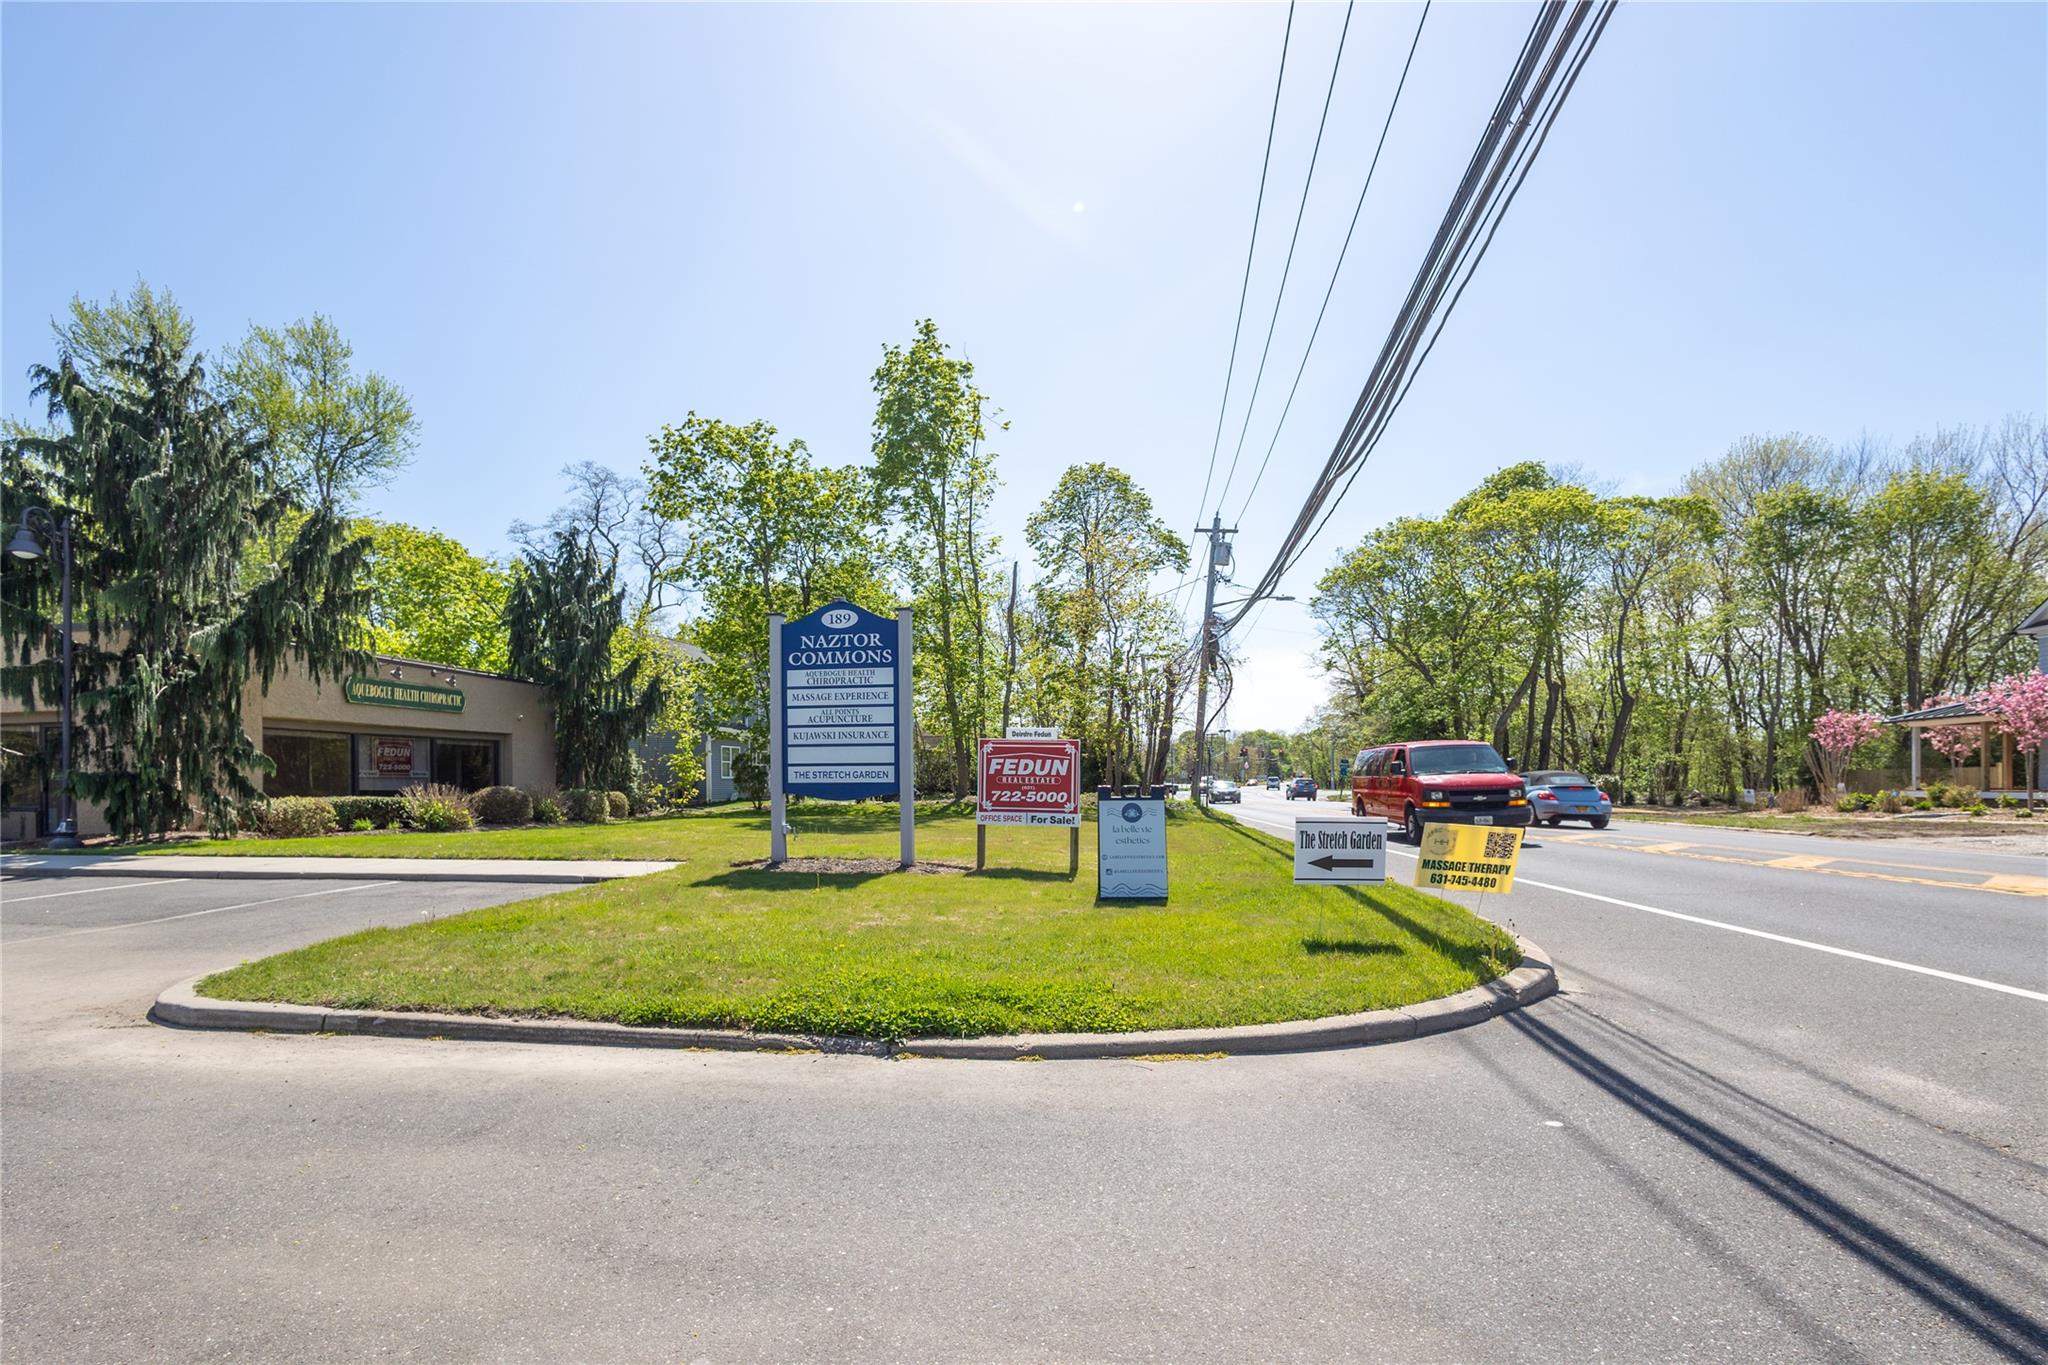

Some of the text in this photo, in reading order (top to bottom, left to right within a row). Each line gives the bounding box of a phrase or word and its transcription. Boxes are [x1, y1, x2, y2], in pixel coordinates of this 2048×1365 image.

[828, 613, 851, 625] 189
[801, 633, 883, 649] NAZTOR
[788, 649, 892, 666] COMMONS
[805, 669, 876, 678] AQUEBOGUE HEALTH
[806, 676, 874, 686] CHIROPRACTIC
[352, 683, 462, 707] AQUEBOGUE HEALTH CHIROPRACTIC
[792, 691, 889, 701] MASSAGE EXPERIENCE
[807, 714, 874, 724] ACUPUNCTURE
[793, 730, 890, 741] KUJAWSKI INSURANCE
[1011, 730, 1052, 738] Deirdre Fedun
[377, 747, 411, 757] FEDUN
[988, 758, 1070, 776] FEDUN
[794, 770, 889, 779] THE STRETCH GARDEN
[1002, 776, 1056, 785] REAL ESTATE
[991, 790, 1068, 803] 722-5000
[980, 815, 1023, 823] OFFICE SPACE
[1030, 815, 1076, 825] For Sale!
[1120, 825, 1140, 834] belle
[1115, 836, 1151, 845] esthetics
[1299, 830, 1383, 850] The Stretch Garden
[1421, 858, 1512, 876] MASSAGE THERAPY
[1429, 872, 1497, 889] 631-745-4480
